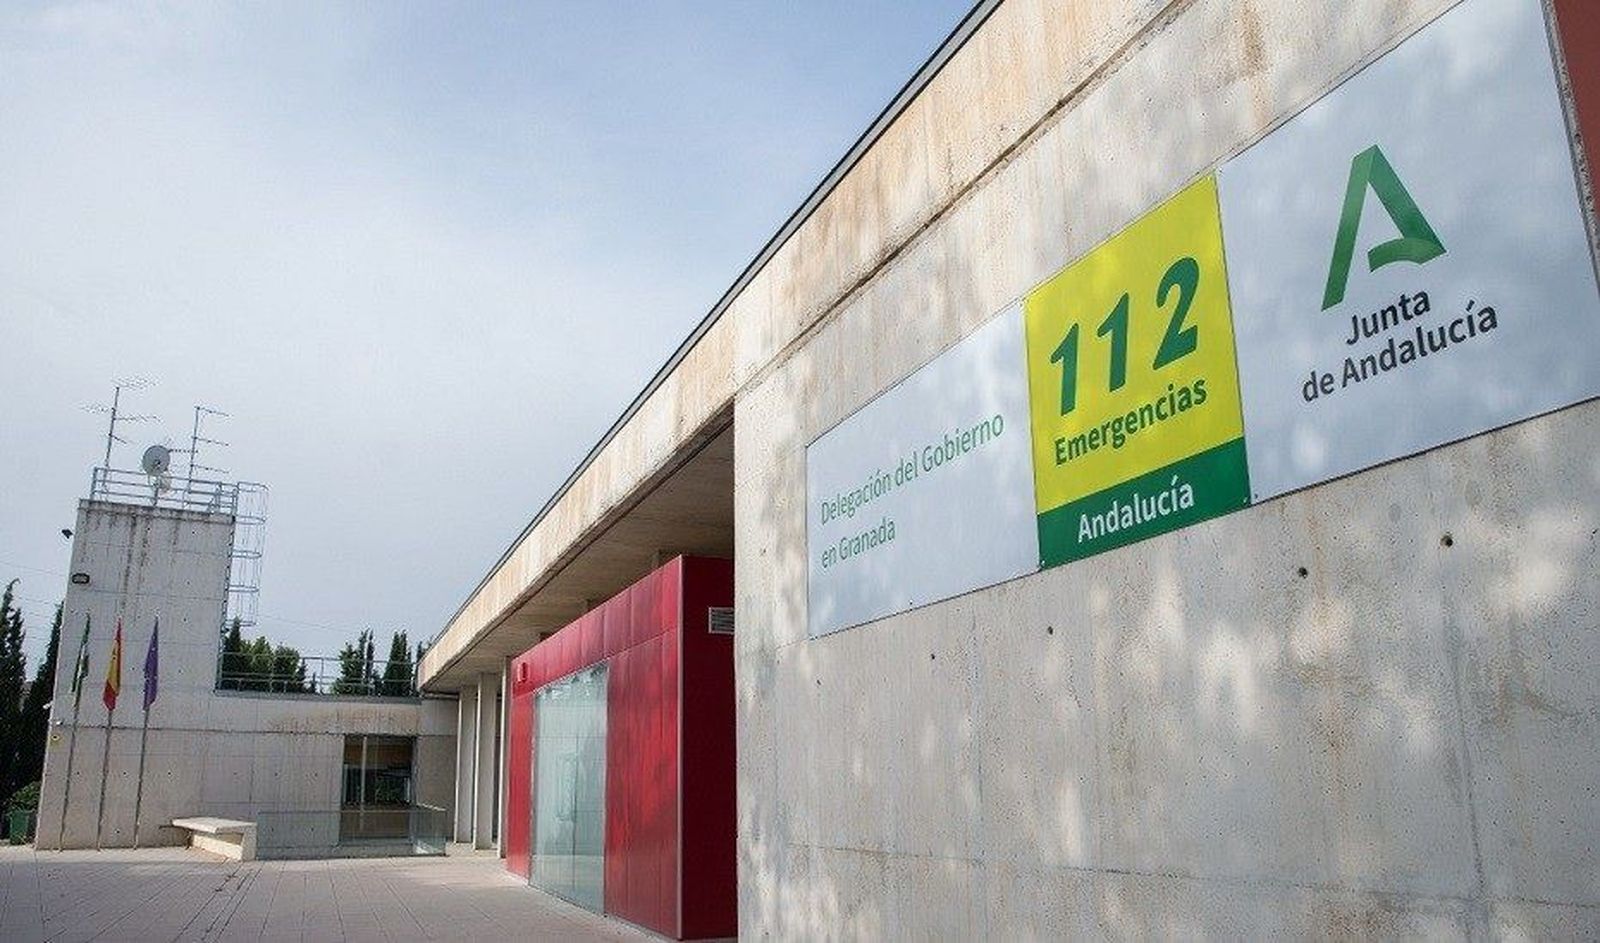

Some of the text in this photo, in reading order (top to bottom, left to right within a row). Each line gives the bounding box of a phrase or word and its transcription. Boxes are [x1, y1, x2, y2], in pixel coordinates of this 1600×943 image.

[1302, 300, 1498, 402] de Andalucía
[1346, 290, 1432, 346] Junta
[1054, 377, 1208, 466] Emergencias
[821, 413, 1005, 525] Delegación del Gobierno
[821, 518, 895, 569] en Granada
[1077, 475, 1195, 544] Andalucía
